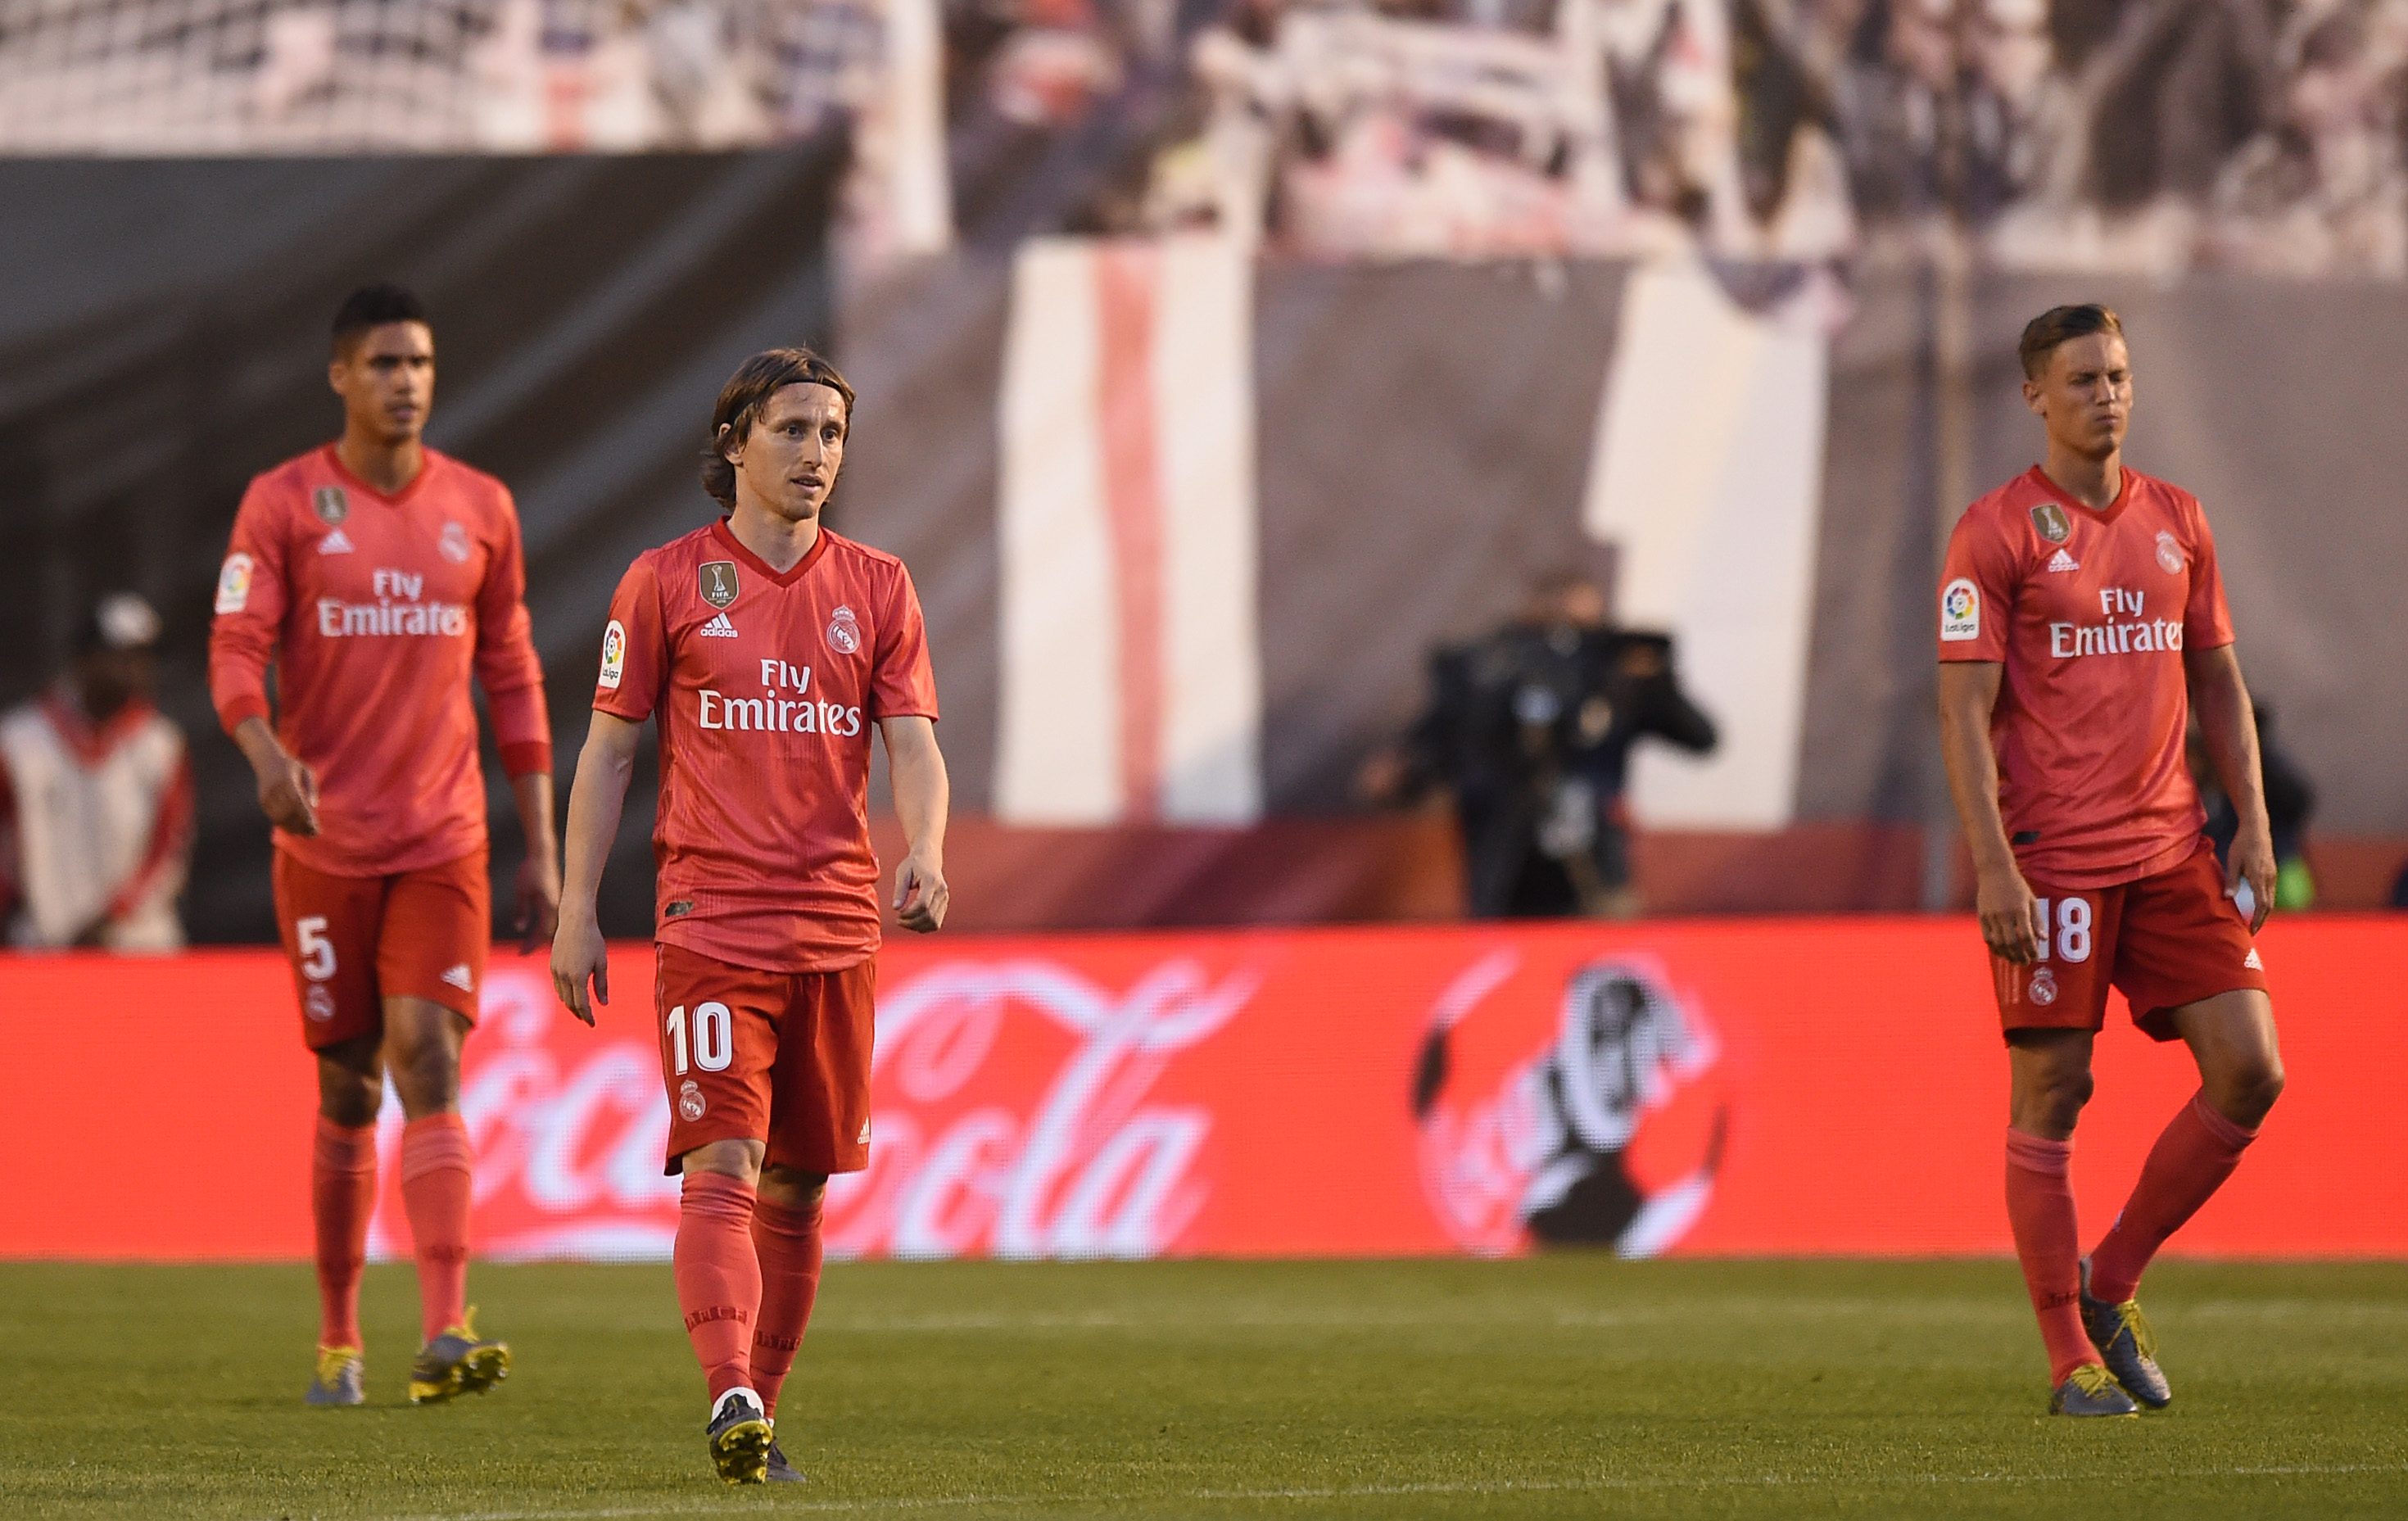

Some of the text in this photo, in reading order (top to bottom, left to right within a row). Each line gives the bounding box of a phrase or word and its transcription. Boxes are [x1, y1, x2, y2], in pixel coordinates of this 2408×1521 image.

[373, 568, 423, 601] Fly
[2099, 587, 2143, 617] Fly
[700, 627, 738, 638] adidas
[761, 659, 811, 695] Fly
[698, 690, 861, 737] Emirates
[296, 917, 337, 982] 5
[667, 1001, 733, 1076] 10
